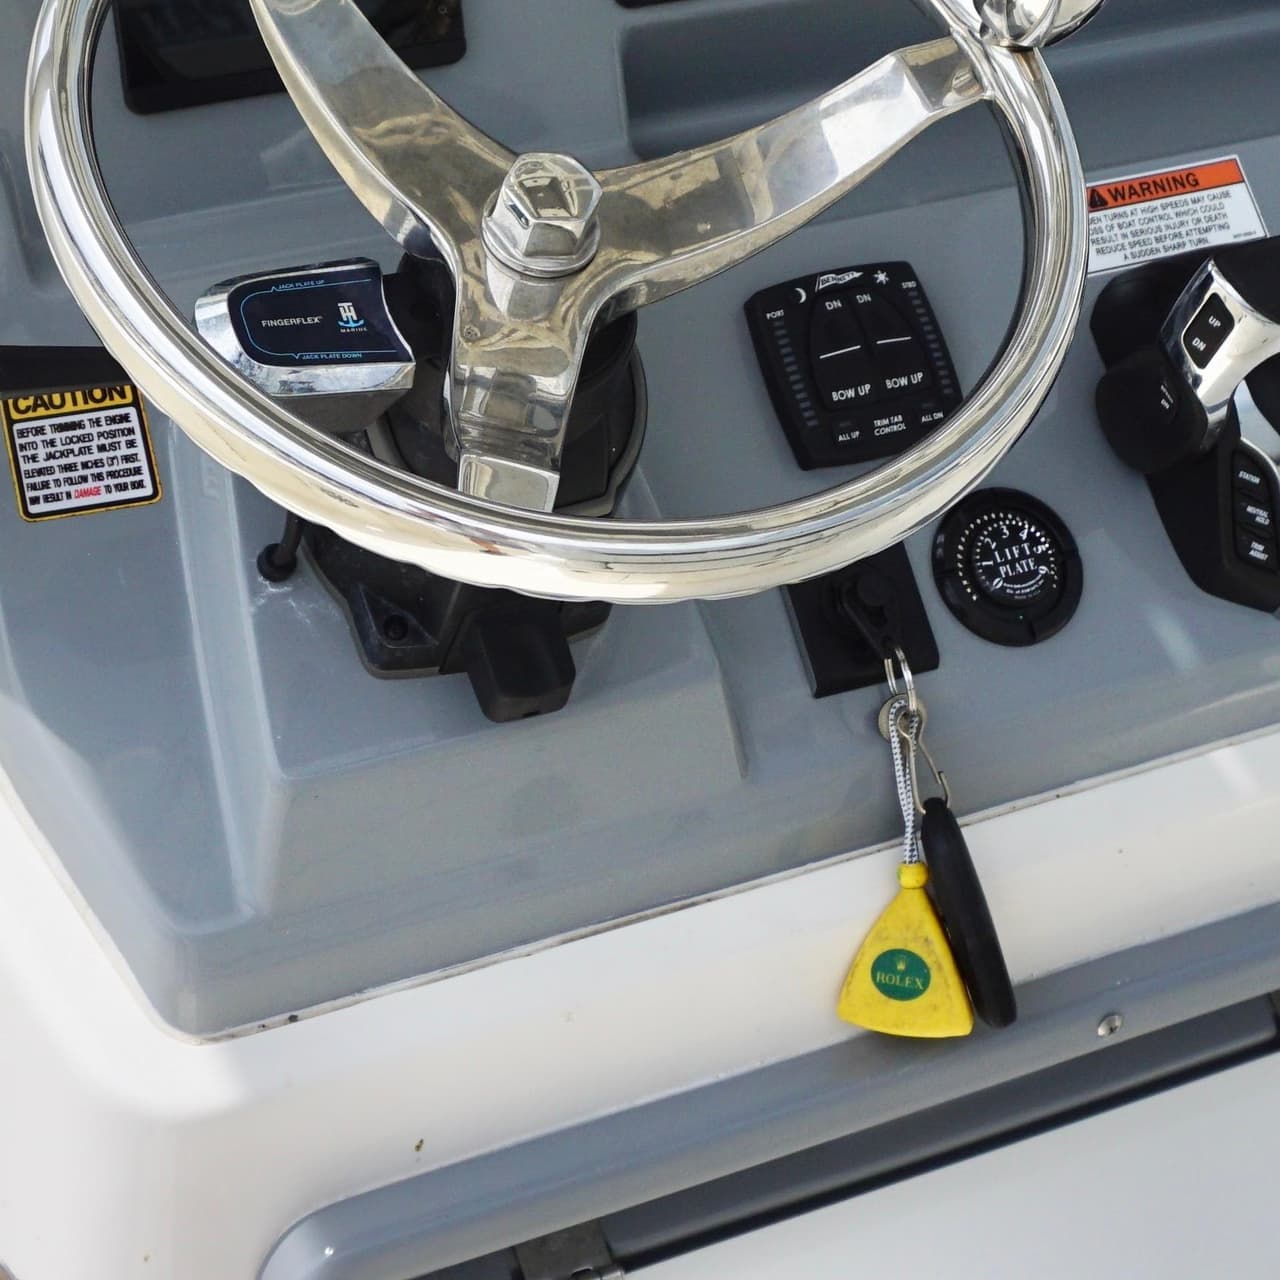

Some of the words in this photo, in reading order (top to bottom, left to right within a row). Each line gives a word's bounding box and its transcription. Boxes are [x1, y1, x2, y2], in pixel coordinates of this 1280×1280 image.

[1107, 172, 1199, 203] WARNING
[1103, 209, 1129, 222] TURNS
[1128, 207, 1139, 217] AT
[1139, 204, 1159, 214] HIGH
[1159, 198, 1189, 211] SPEEDS
[1189, 194, 1206, 204] MAY
[1205, 189, 1232, 202] CAUSE
[1103, 223, 1115, 232] OF
[1115, 218, 1137, 230] BOAT
[1136, 211, 1173, 226] CONTROL
[1173, 206, 1199, 219] WHICH
[1198, 201, 1225, 213] COULD
[1089, 232, 1119, 246] RESULT
[1119, 231, 1128, 240] IN
[1128, 223, 1162, 238] SERIOUS
[1163, 218, 1190, 231] INJURY
[1190, 216, 1203, 225] OR
[1094, 241, 1127, 256] REDUCE
[1126, 236, 1153, 249] SPEED
[1153, 229, 1184, 243] BEFORE
[1183, 220, 1231, 238] ATTEMPTING
[1122, 253, 1129, 261] A
[1129, 245, 1161, 259] SUDDEN
[1161, 240, 1187, 252] SHARP
[821, 272, 856, 285] BENNETT
[901, 281, 917, 289] STBD
[825, 299, 843, 311] DN
[856, 293, 872, 304] DN
[766, 309, 785, 320] PORT
[1208, 315, 1221, 328] UP
[1192, 337, 1207, 351] DN
[885, 376, 908, 389] BOW
[910, 372, 924, 384] UP
[12, 385, 127, 414] CAUTION
[831, 387, 855, 401] BOW
[857, 383, 871, 396] UP
[15, 424, 47, 439] BEFORE
[87, 415, 102, 428] THE
[103, 410, 131, 425] ENGINE
[873, 417, 889, 427] TRIM
[890, 414, 903, 424] TAB
[921, 415, 932, 423] ALL
[933, 412, 944, 420] DN
[18, 440, 38, 453] INTO
[40, 437, 57, 449] THE
[59, 431, 94, 446] LOCKED
[96, 425, 135, 441] POSITION
[838, 434, 850, 442] ALL
[850, 431, 860, 439] UP
[874, 423, 907, 436] CONTROL
[21, 453, 40, 465] THE
[41, 444, 93, 461] JACKPLATE
[96, 440, 122, 453] MUST
[124, 437, 137, 448] BE
[23, 465, 56, 480] ELEVATED
[56, 461, 79, 474] THREE
[80, 457, 105, 471] INCHES
[1238, 471, 1261, 485] STATION
[25, 479, 51, 492] FAILURE
[52, 478, 61, 488] TO
[62, 474, 89, 486] FOLLOW
[90, 471, 104, 482] THIS
[42, 491, 64, 503] RESULT
[64, 490, 72, 500] IN
[72, 485, 102, 499] DAMAGE
[103, 484, 112, 494] TO
[112, 481, 129, 493] YOUR
[984, 537, 997, 550] 2
[1000, 525, 1010, 539] 3
[1019, 528, 1029, 540] 4
[994, 542, 1030, 563] LIFT
[999, 558, 1038, 578] PLATE
[876, 971, 924, 991] ROLEX
